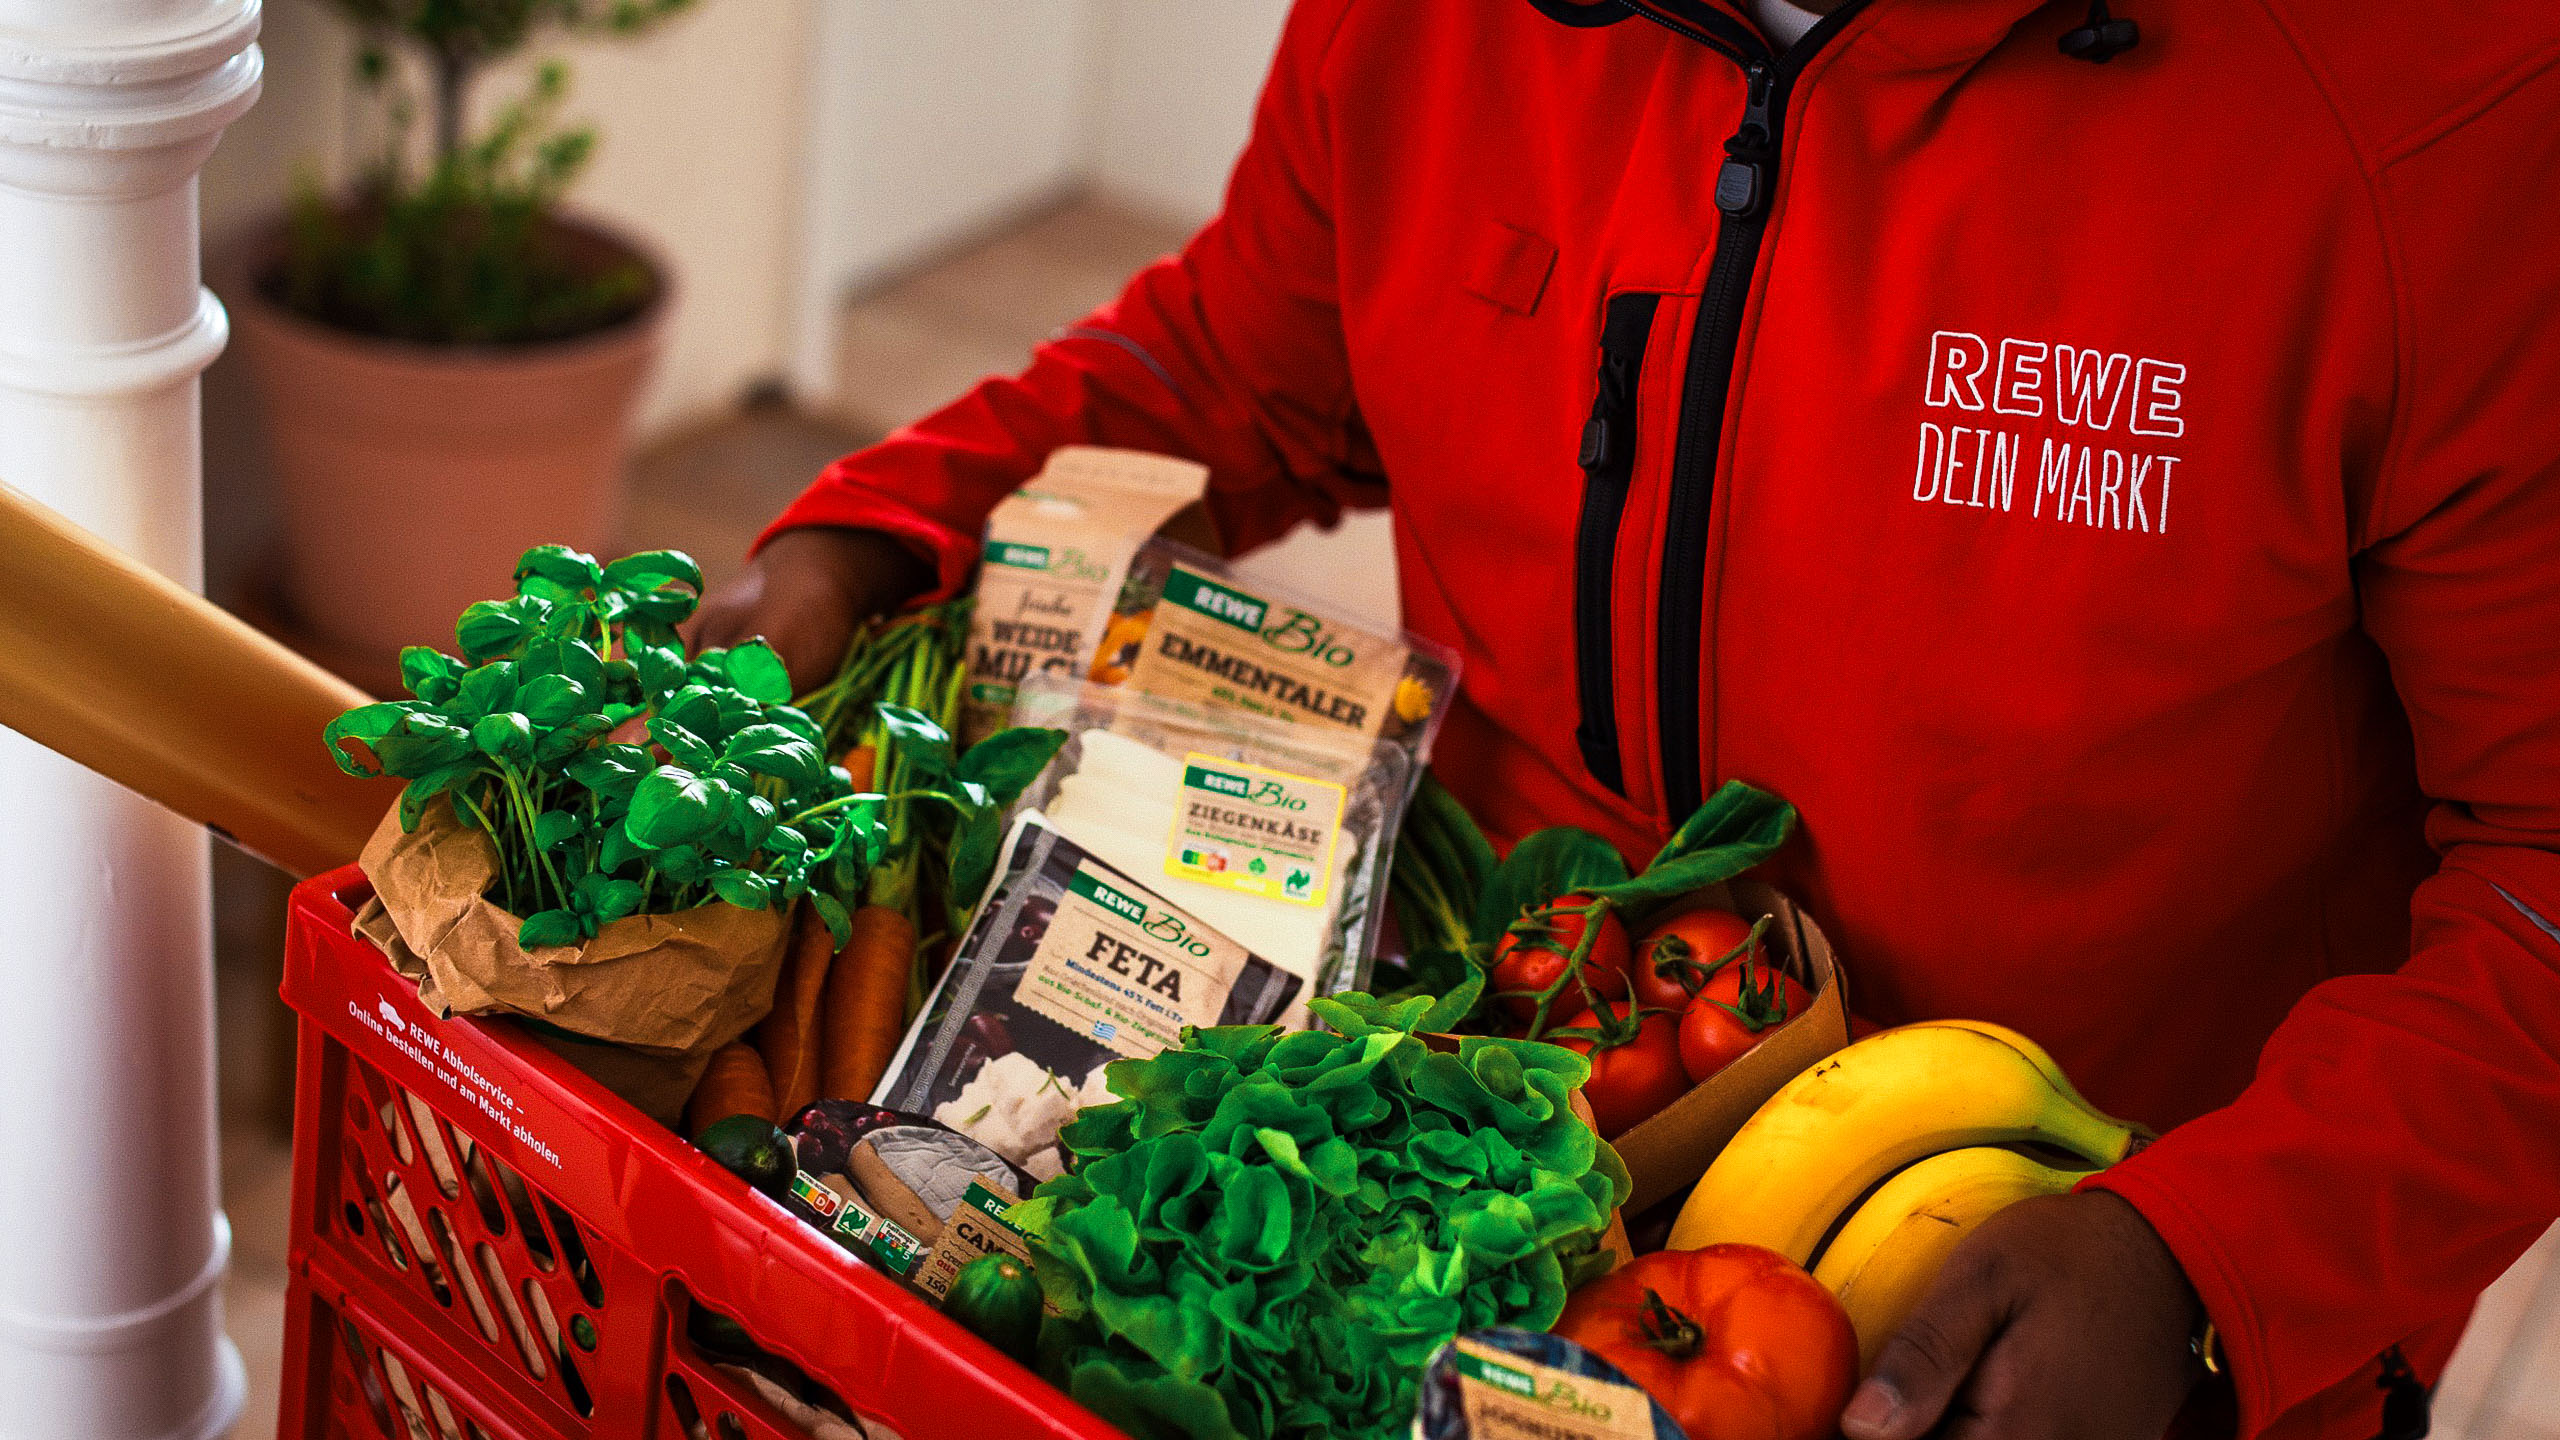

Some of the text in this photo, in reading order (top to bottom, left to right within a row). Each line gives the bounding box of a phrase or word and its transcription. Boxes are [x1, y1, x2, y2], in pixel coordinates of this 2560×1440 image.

[1925, 330, 2186, 438] REWE
[1913, 422, 2181, 534] DEIN MARKT
[1194, 585, 1354, 667] REWE Bio
[1158, 631, 1367, 730] EMMENTALER
[1203, 773, 1307, 811] REWE Bio
[1092, 886, 1211, 958] REWE Bio
[1085, 931, 1182, 1004] FETA
[349, 1000, 563, 1170] Online bestellen und am Markt abholen.
[409, 1021, 441, 1056] REWE
[442, 1046, 514, 1110] Abholservice
[925, 1275, 947, 1295] 150
